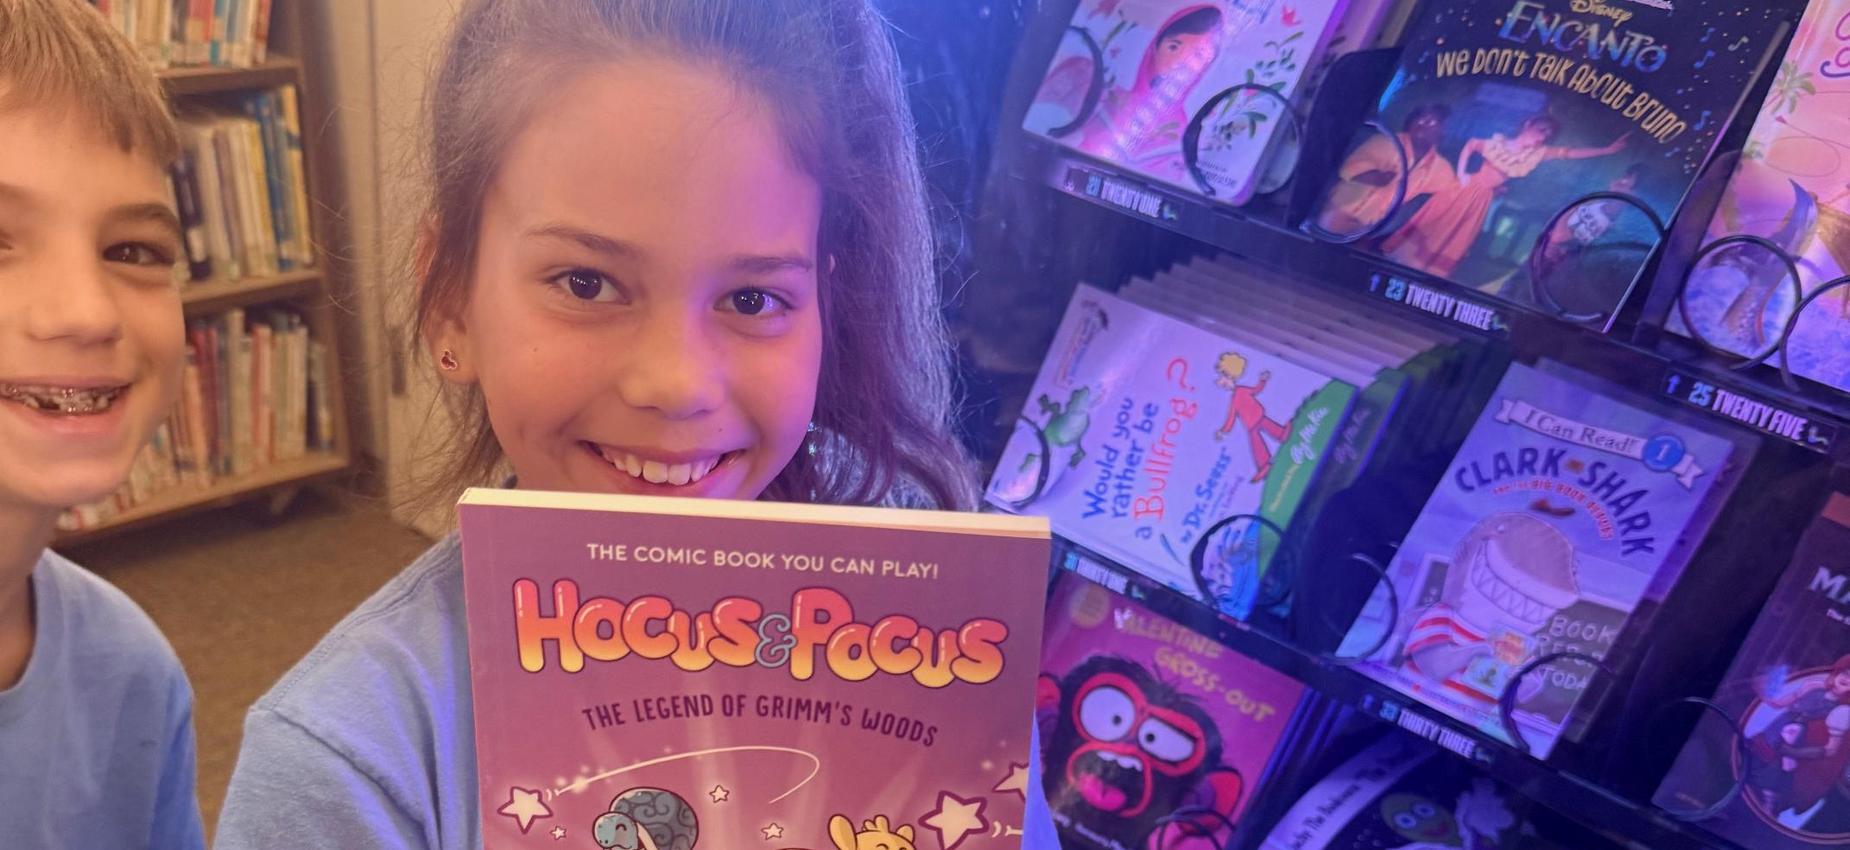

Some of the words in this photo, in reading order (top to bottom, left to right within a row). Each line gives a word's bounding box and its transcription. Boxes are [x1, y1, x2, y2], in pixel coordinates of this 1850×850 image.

[1499, 0, 1668, 72] ENCANTO
[1436, 51, 1469, 79] We
[1384, 276, 1407, 301] 23
[1405, 284, 1455, 318] TWENTY
[1453, 300, 1496, 331] THREE
[1537, 415, 1575, 440] Can
[1688, 381, 1715, 407] 25
[1712, 388, 1774, 428] TWENTY
[1767, 409, 1808, 441] FIVE
[1082, 444, 1121, 521] Would
[1110, 396, 1134, 441] you
[1110, 441, 1145, 520] rather
[1142, 402, 1160, 437] be
[1454, 446, 1569, 492] CLARK
[1577, 461, 1656, 558] SHARK
[587, 543, 627, 562] THE
[634, 546, 707, 566] COMIC
[714, 549, 775, 570] BOOK
[780, 554, 824, 573] YOU
[830, 557, 876, 576] CAN
[882, 561, 938, 579] PLAY!
[512, 578, 762, 673] HOCUS
[790, 587, 1009, 688] POCUS
[1550, 615, 1619, 644] BOOK
[1154, 646, 1277, 722] GROSS-OUT
[582, 704, 625, 732] THE
[633, 695, 714, 724] LEGEND
[721, 695, 746, 718] OF
[755, 695, 852, 727] GRIMM'S
[862, 709, 938, 748] WOODS
[1437, 726, 1477, 760] THREE
